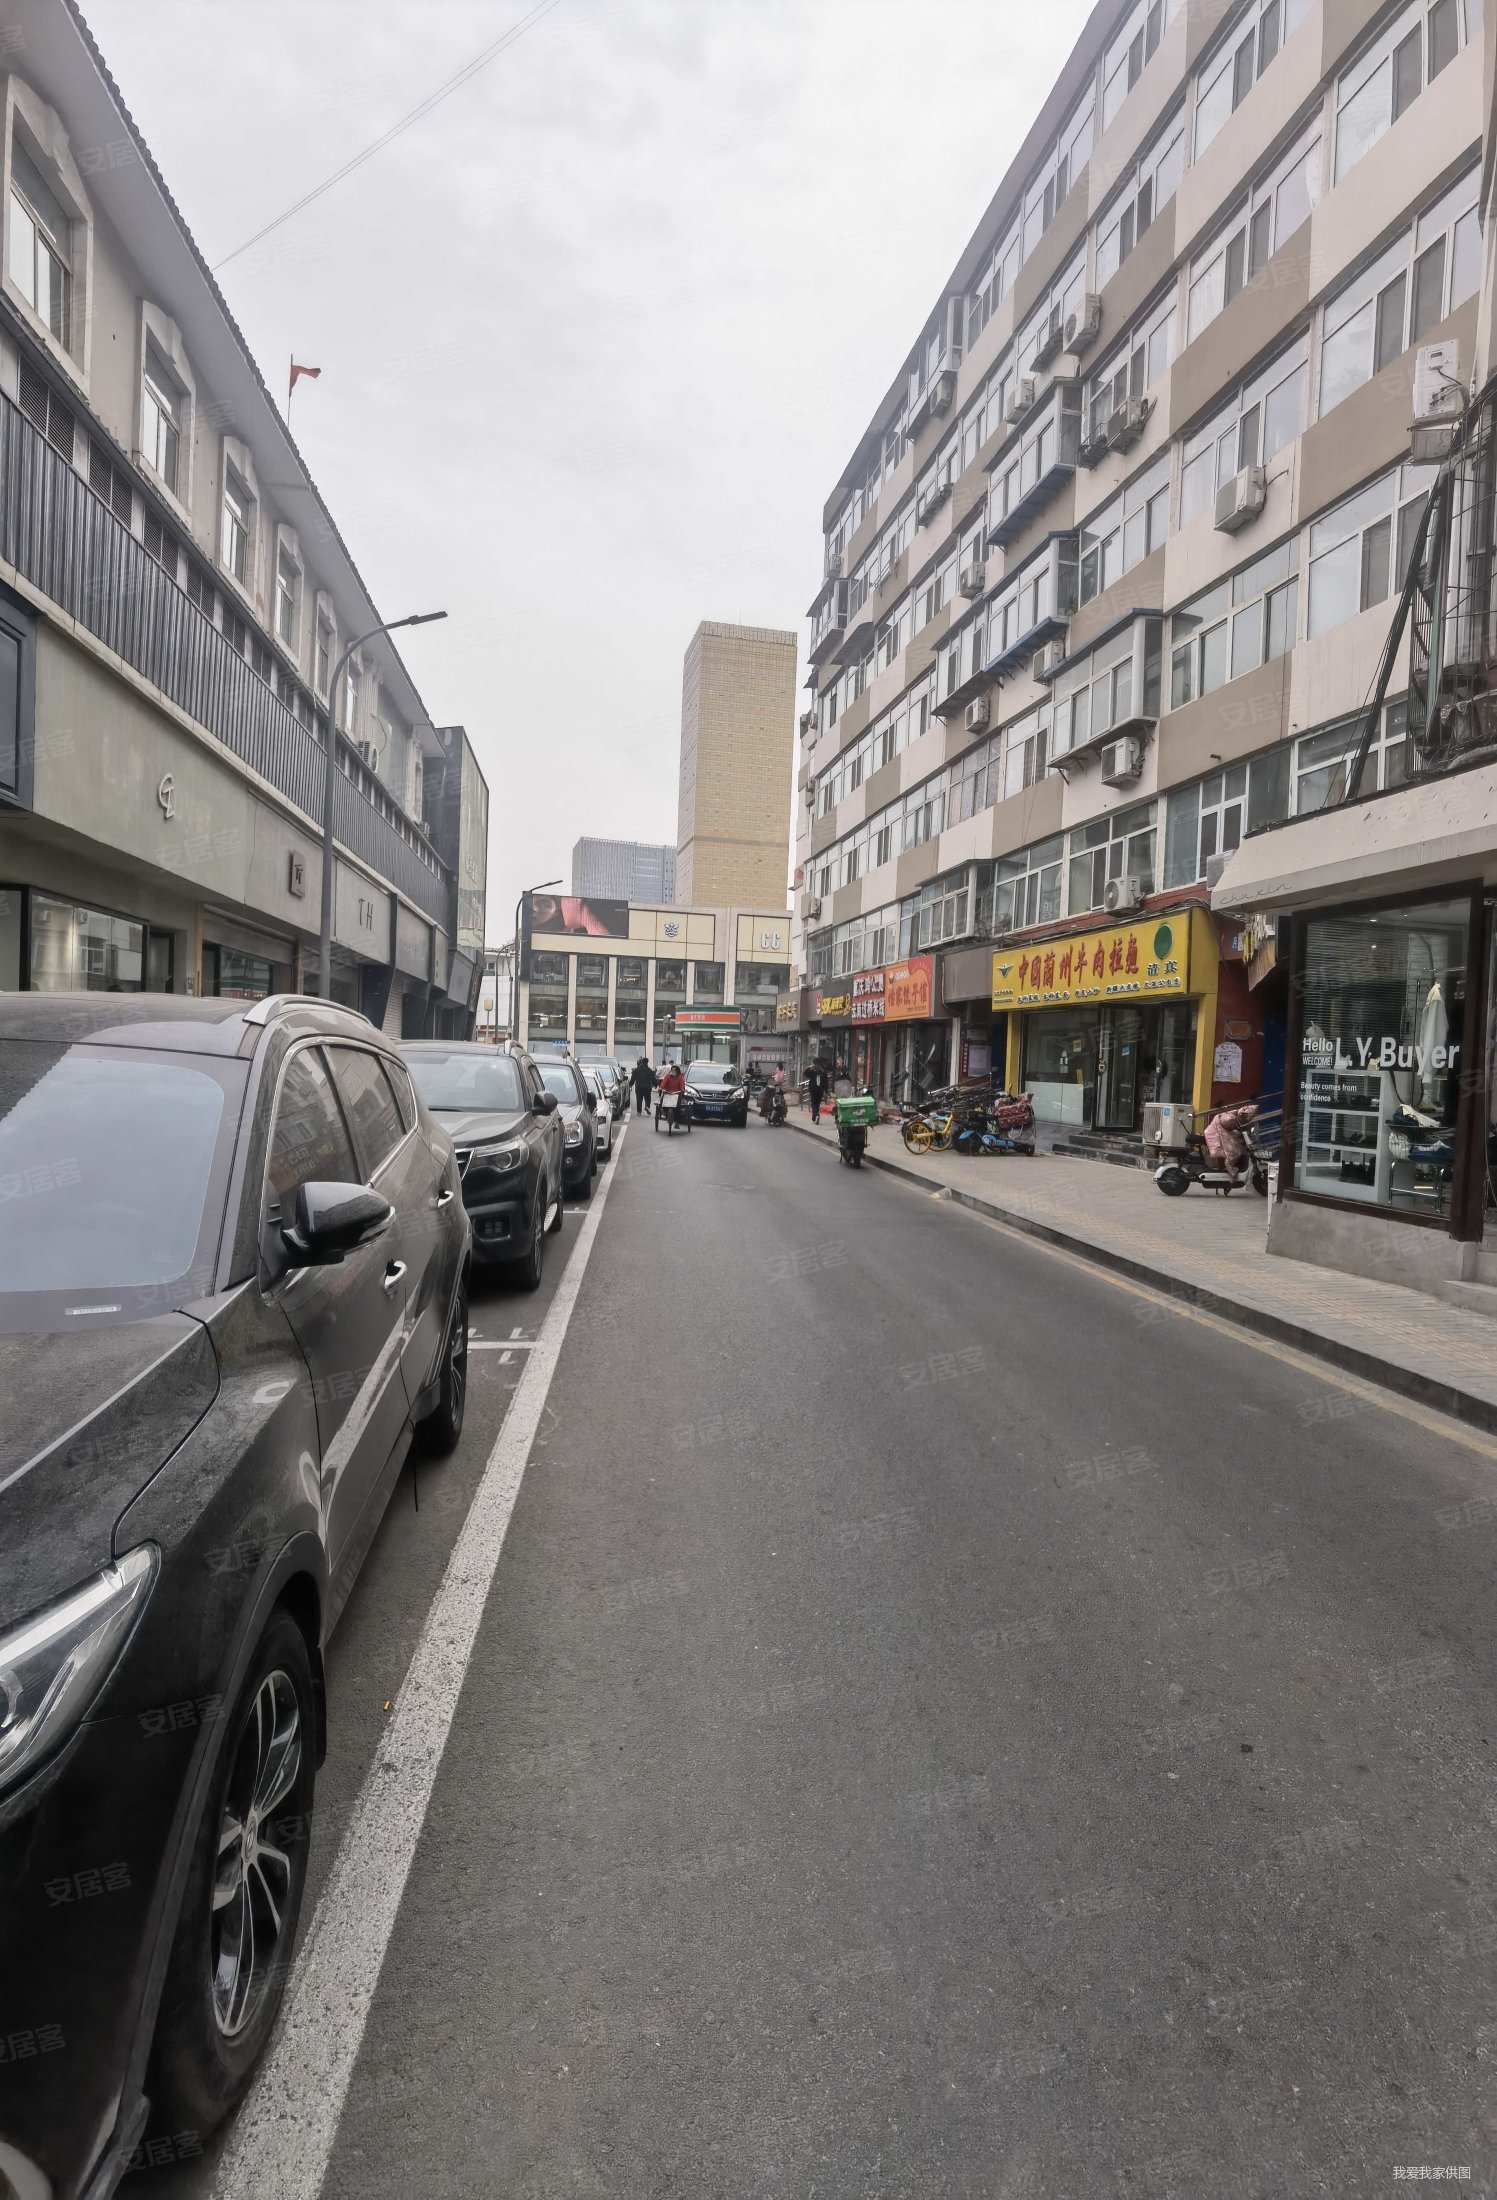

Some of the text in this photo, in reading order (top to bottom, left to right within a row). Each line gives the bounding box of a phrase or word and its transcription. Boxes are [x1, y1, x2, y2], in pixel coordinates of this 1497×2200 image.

[1147, 960, 1178, 976] 清真
[1303, 1038, 1334, 1052] Hello
[1302, 1056, 1333, 1066] WELCOME!
[1301, 1081, 1358, 1093] Beauty comes from
[1300, 1093, 1332, 1102] confidence
